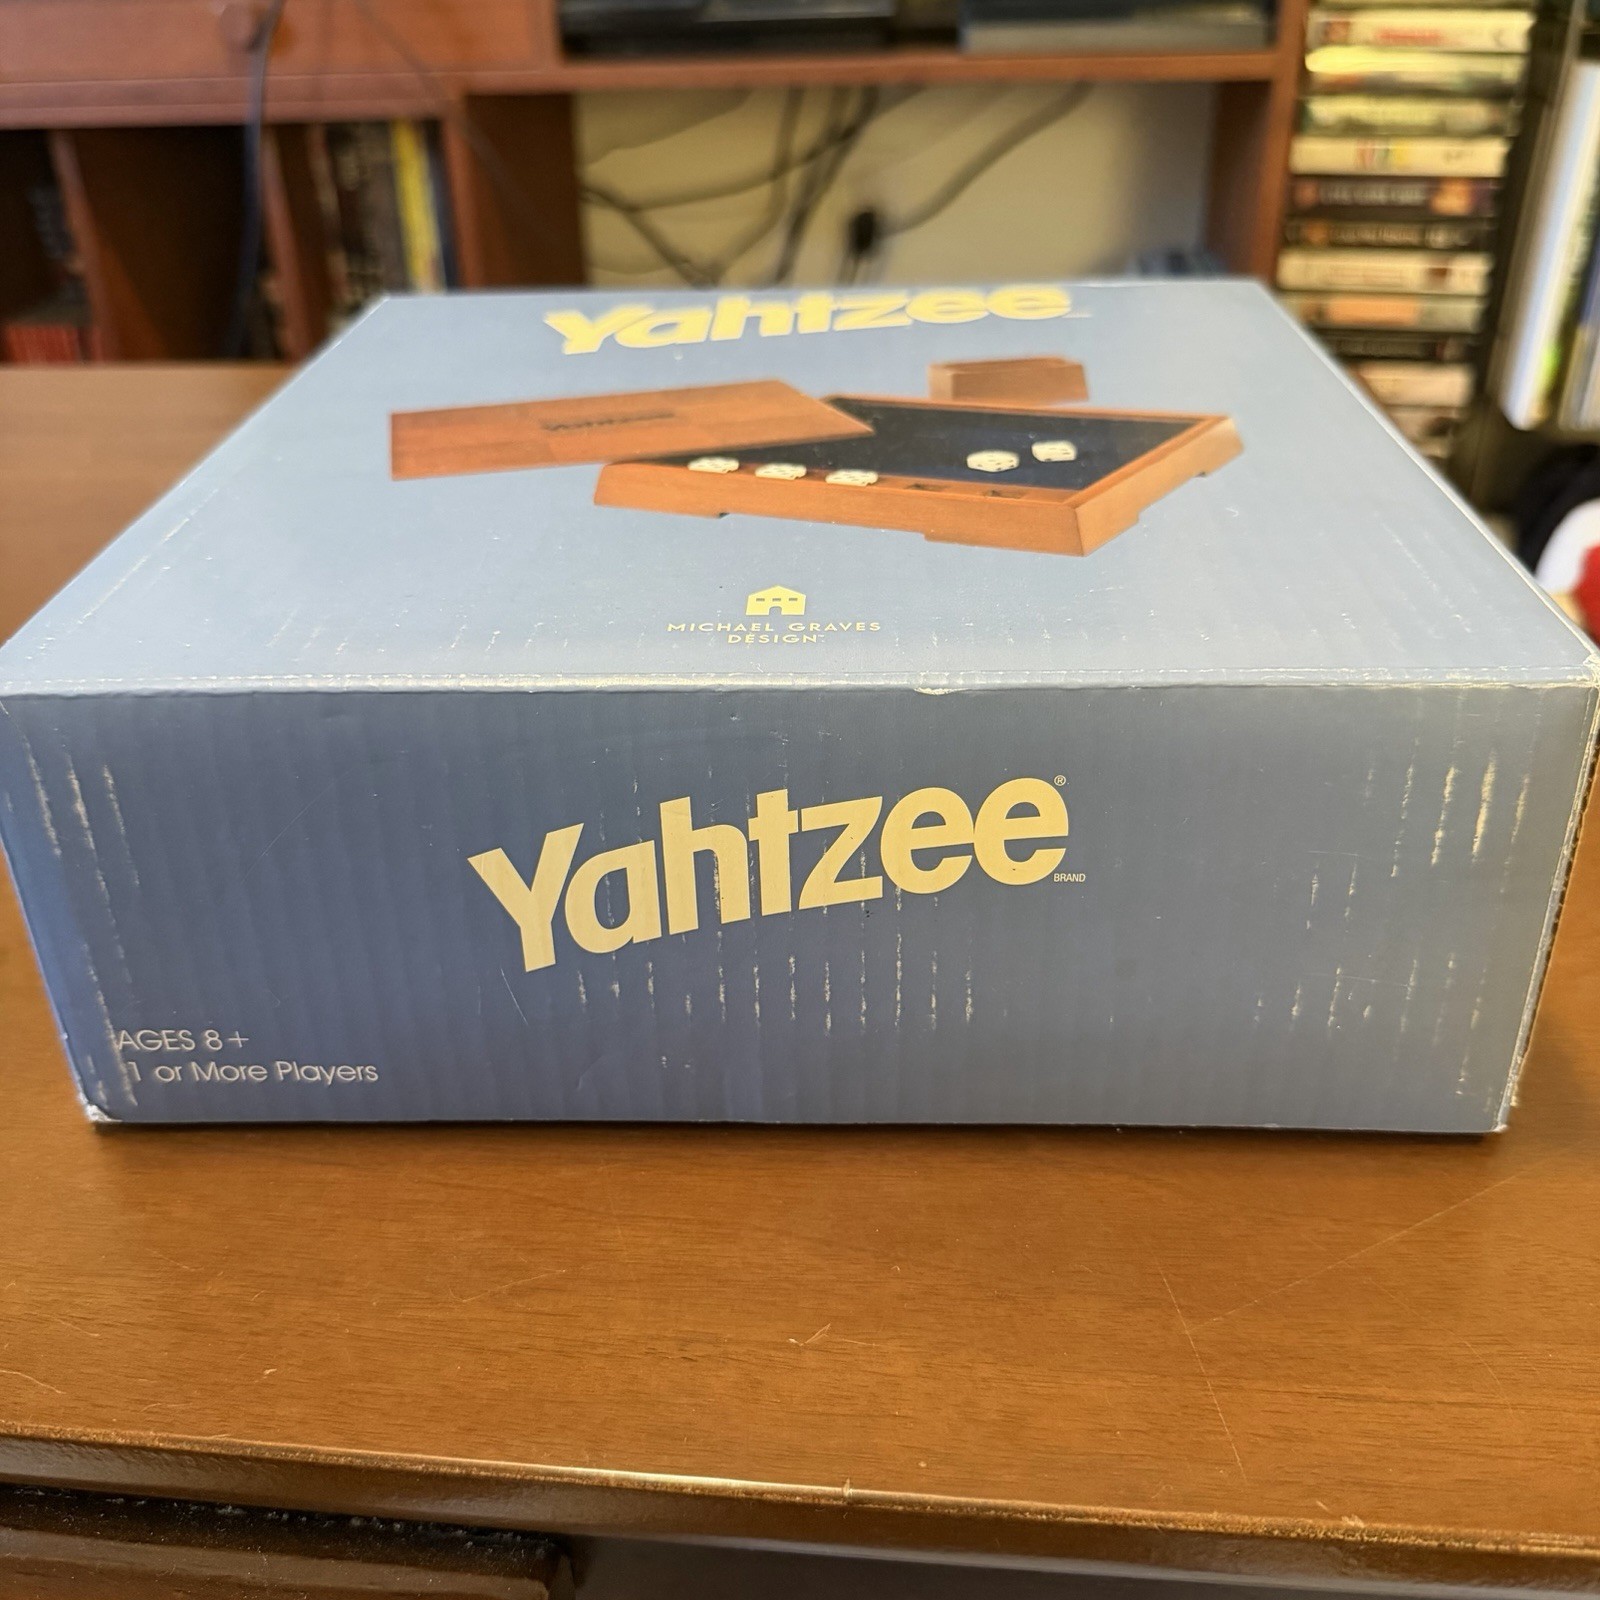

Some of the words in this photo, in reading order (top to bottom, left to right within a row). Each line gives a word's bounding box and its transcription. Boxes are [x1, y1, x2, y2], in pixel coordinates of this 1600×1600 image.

[544, 284, 1072, 355] Yahtzee
[667, 622, 775, 633] MICHAEL
[788, 621, 882, 632] GRAVES
[467, 777, 1069, 973] Yahtzee
[1053, 872, 1087, 883] BRAND
[118, 1029, 196, 1051] AGES
[126, 1061, 142, 1081] 1
[155, 1064, 182, 1083] or
[190, 1061, 268, 1082] More
[274, 1060, 379, 1086] Players
